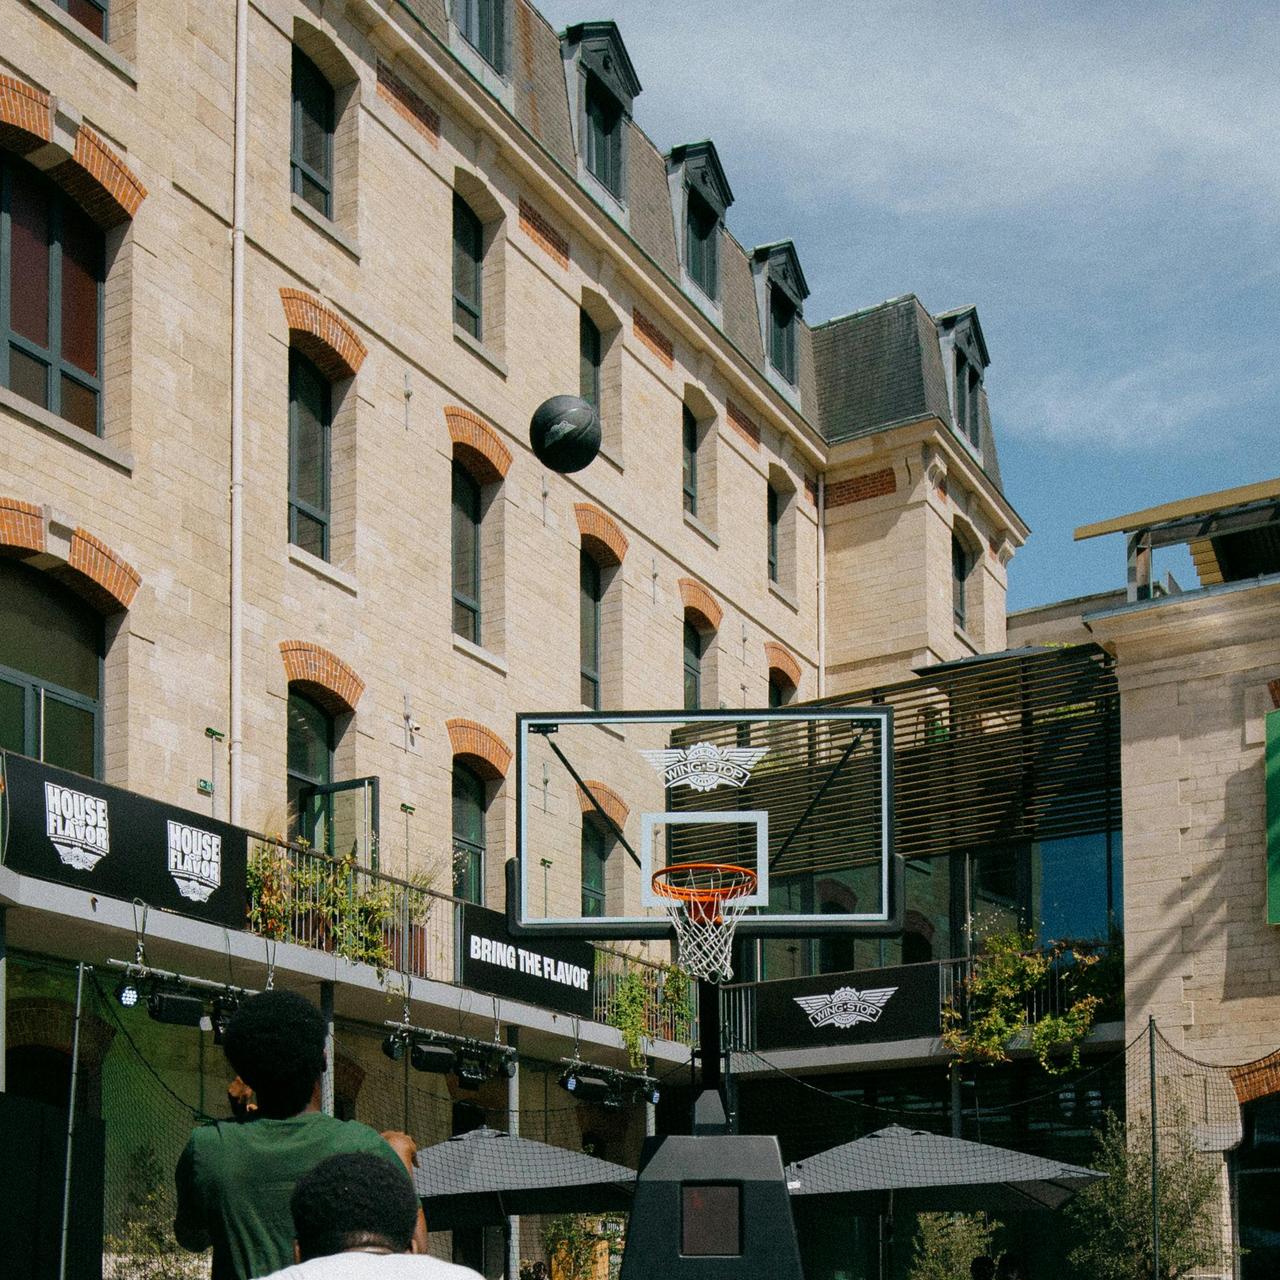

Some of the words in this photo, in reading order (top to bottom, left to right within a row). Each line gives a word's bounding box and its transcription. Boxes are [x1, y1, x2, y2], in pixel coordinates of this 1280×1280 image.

[47, 784, 108, 829] HOUSE
[49, 814, 109, 851] FLAVOR
[170, 822, 221, 862] HOUSE
[171, 851, 220, 882] FLAVOR
[470, 935, 517, 970] BRING
[518, 948, 543, 977] THE
[543, 956, 589, 991] FLAVOR
